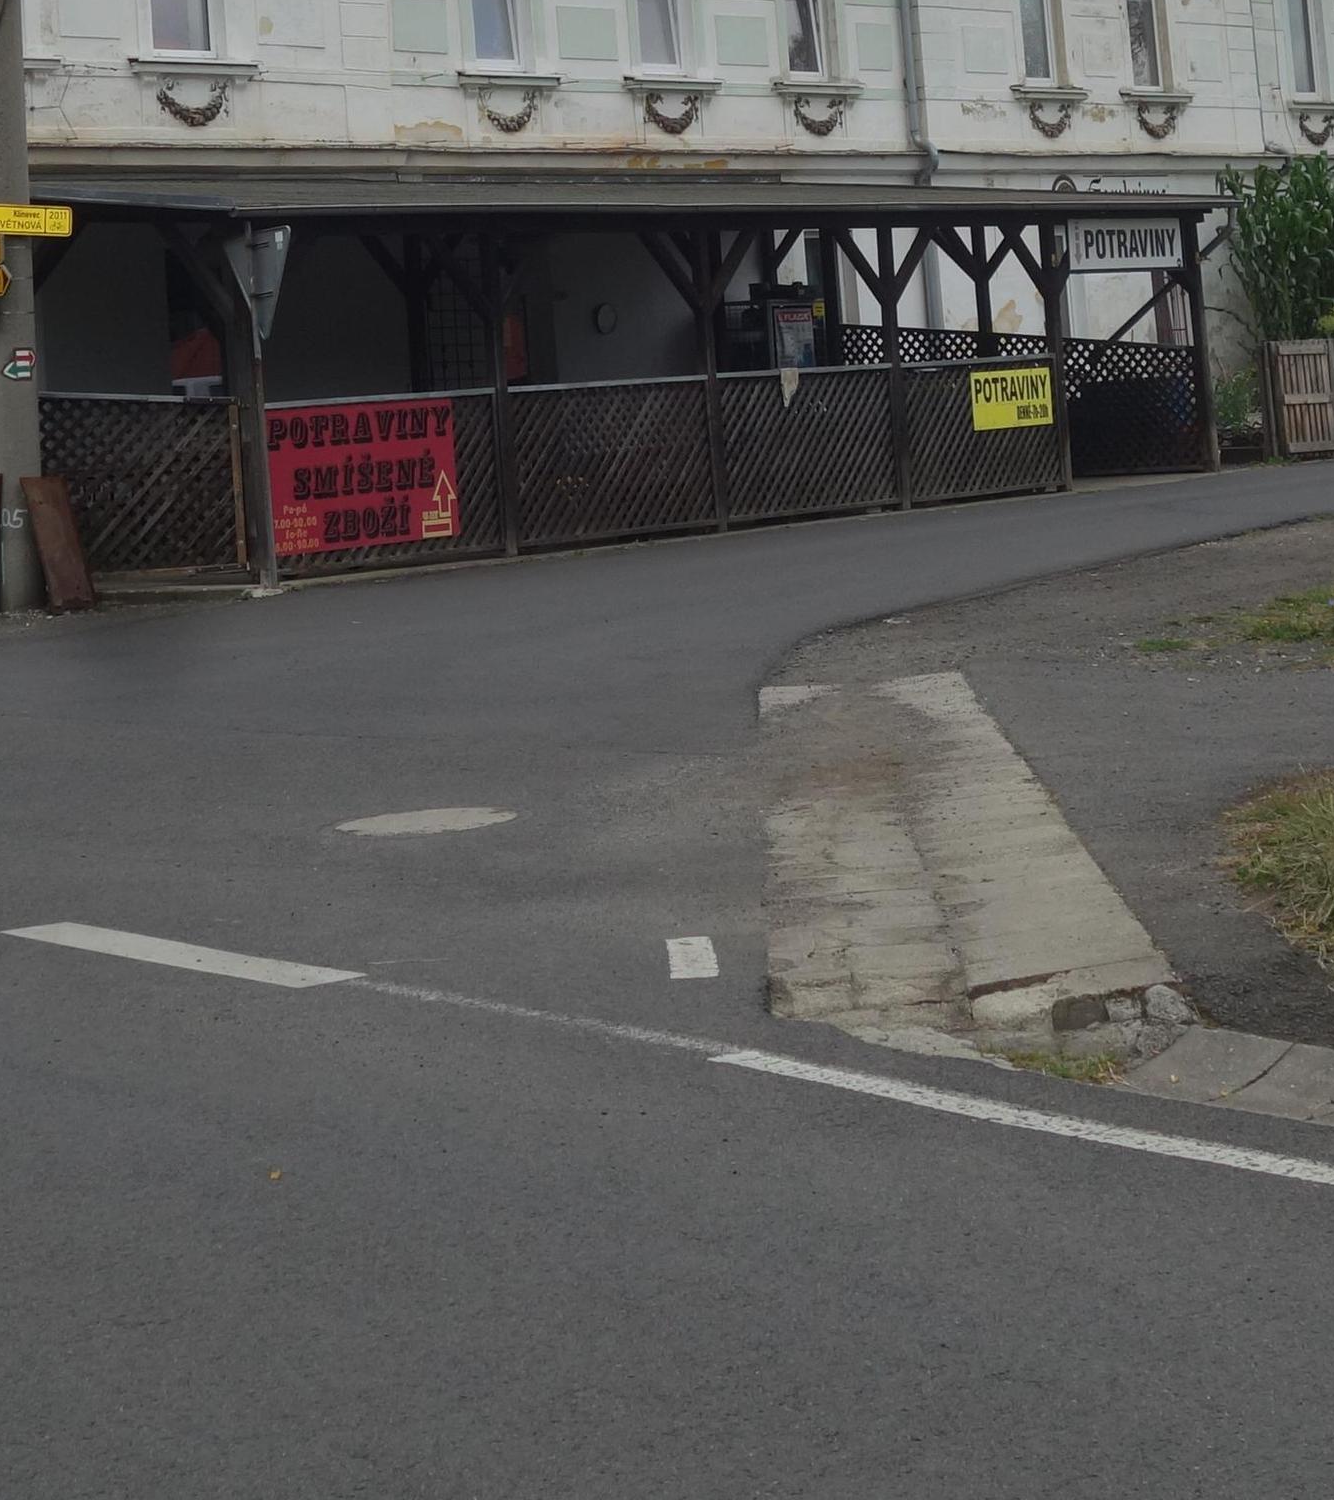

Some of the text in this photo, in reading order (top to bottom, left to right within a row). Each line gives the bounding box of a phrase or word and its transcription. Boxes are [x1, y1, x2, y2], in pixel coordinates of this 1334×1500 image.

[49, 211, 67, 220] 2011
[1084, 228, 1175, 259] POTRAVINY
[973, 374, 1047, 404] POTRAVINY
[267, 406, 451, 451] POTRAVINY
[293, 449, 435, 500] SMÍŠENÉ
[1, 508, 28, 529] 05
[324, 496, 411, 543] ZBOŽÍ
